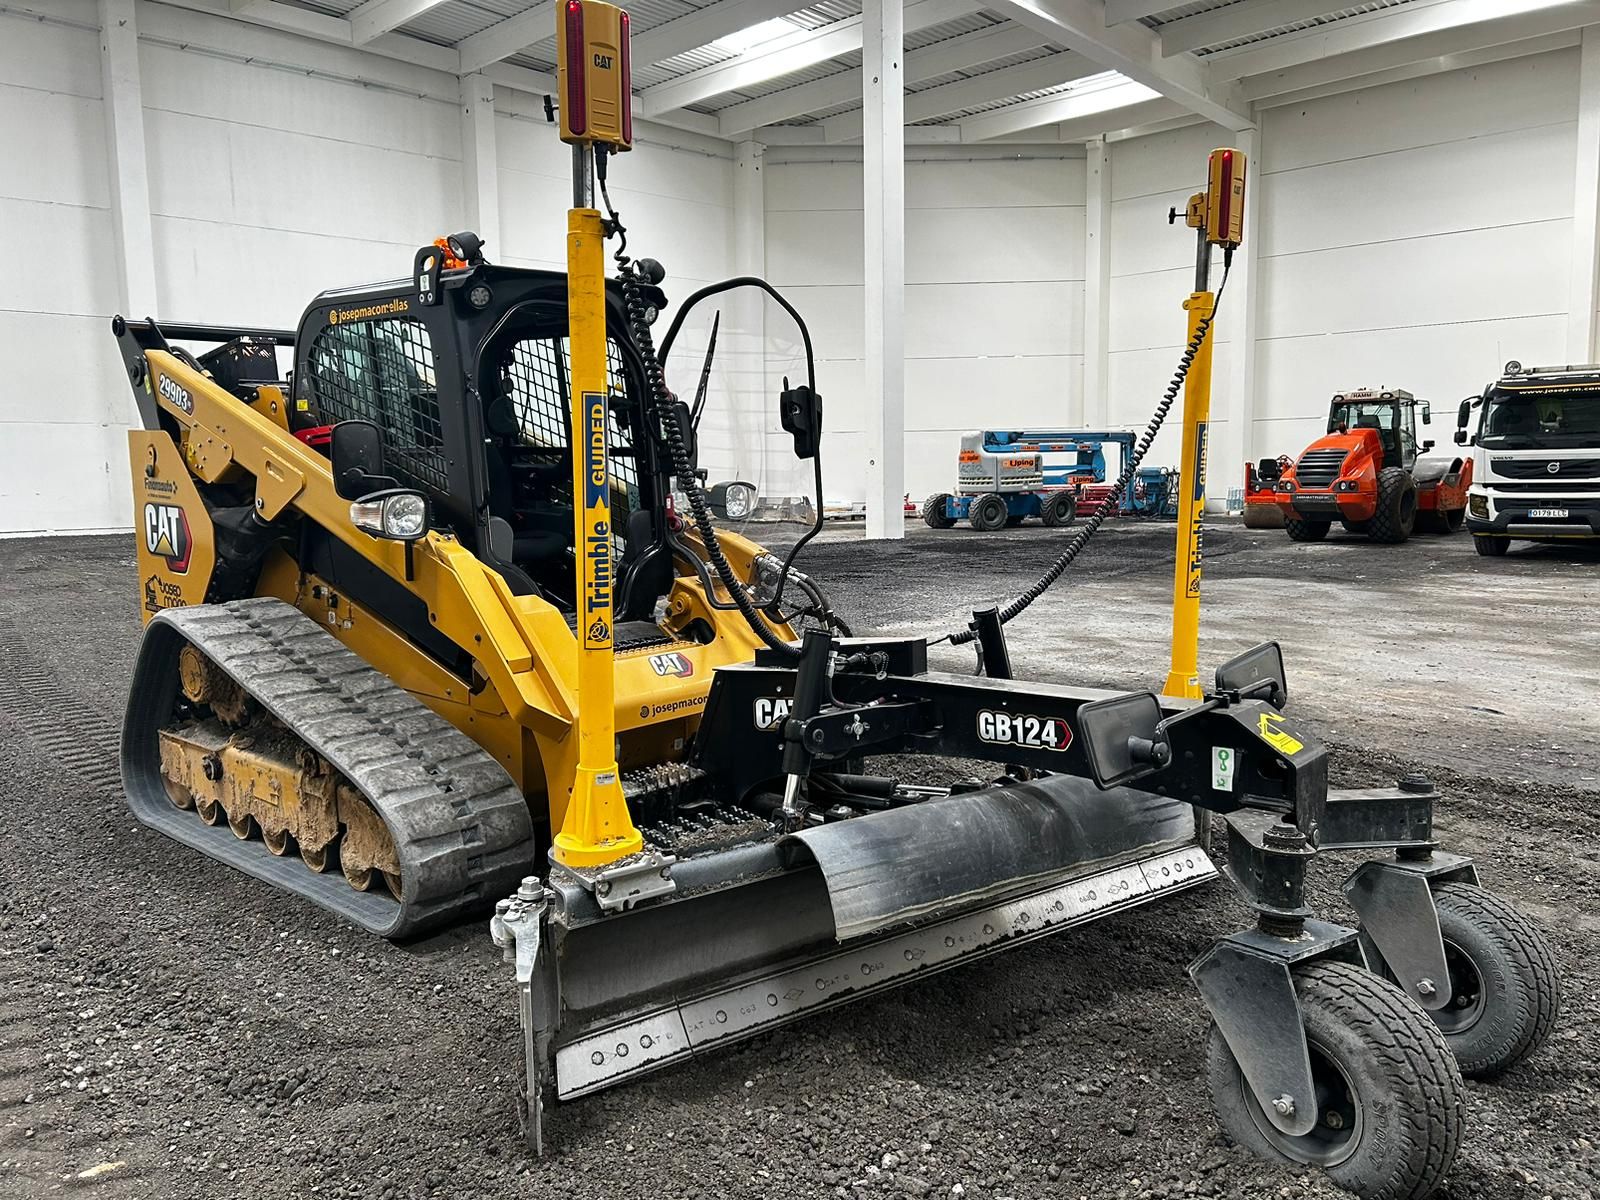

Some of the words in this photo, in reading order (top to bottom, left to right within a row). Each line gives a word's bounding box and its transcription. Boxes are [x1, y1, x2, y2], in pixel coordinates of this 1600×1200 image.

[594, 54, 614, 70] CAT
[160, 374, 187, 410] 299D3
[592, 403, 606, 486] GUIDED
[1010, 459, 1034, 467] Uping
[145, 504, 179, 556] CAT
[588, 521, 609, 613] Trimble
[650, 653, 684, 675] CAT
[979, 712, 1057, 747] GB124
